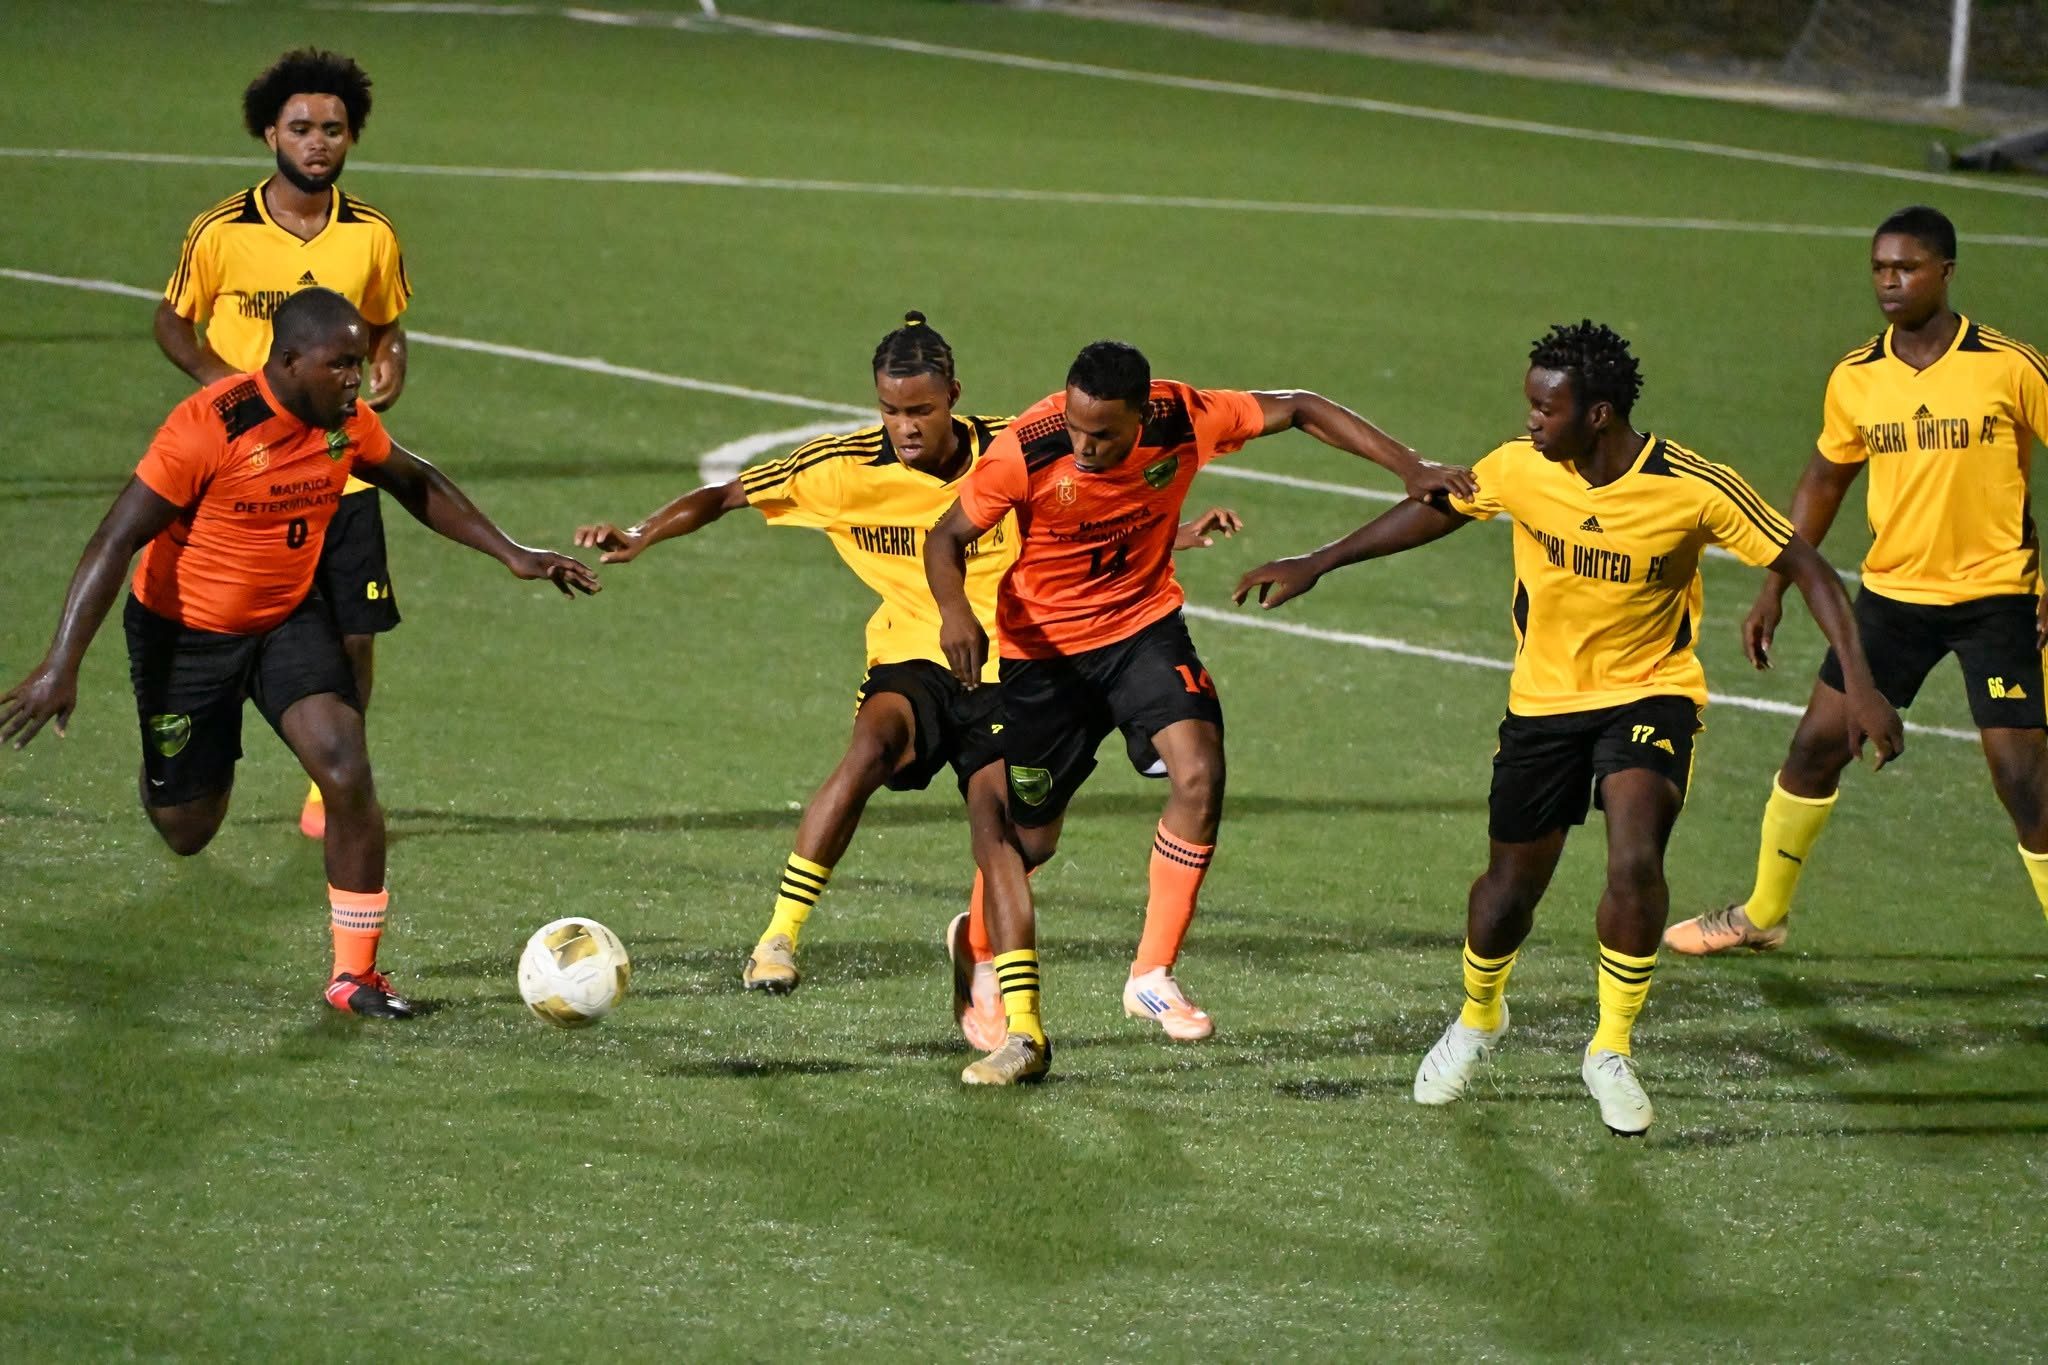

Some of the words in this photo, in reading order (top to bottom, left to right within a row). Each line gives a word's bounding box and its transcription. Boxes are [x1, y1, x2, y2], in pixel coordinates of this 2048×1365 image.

[1916, 418, 1969, 450] UNITED
[286, 517, 309, 549] 0
[850, 526, 916, 557] TIMEHRI
[1573, 544, 1631, 584] UNITED
[1645, 555, 1669, 584] FC
[1987, 677, 2006, 699] 66
[1631, 724, 1656, 744] 17
